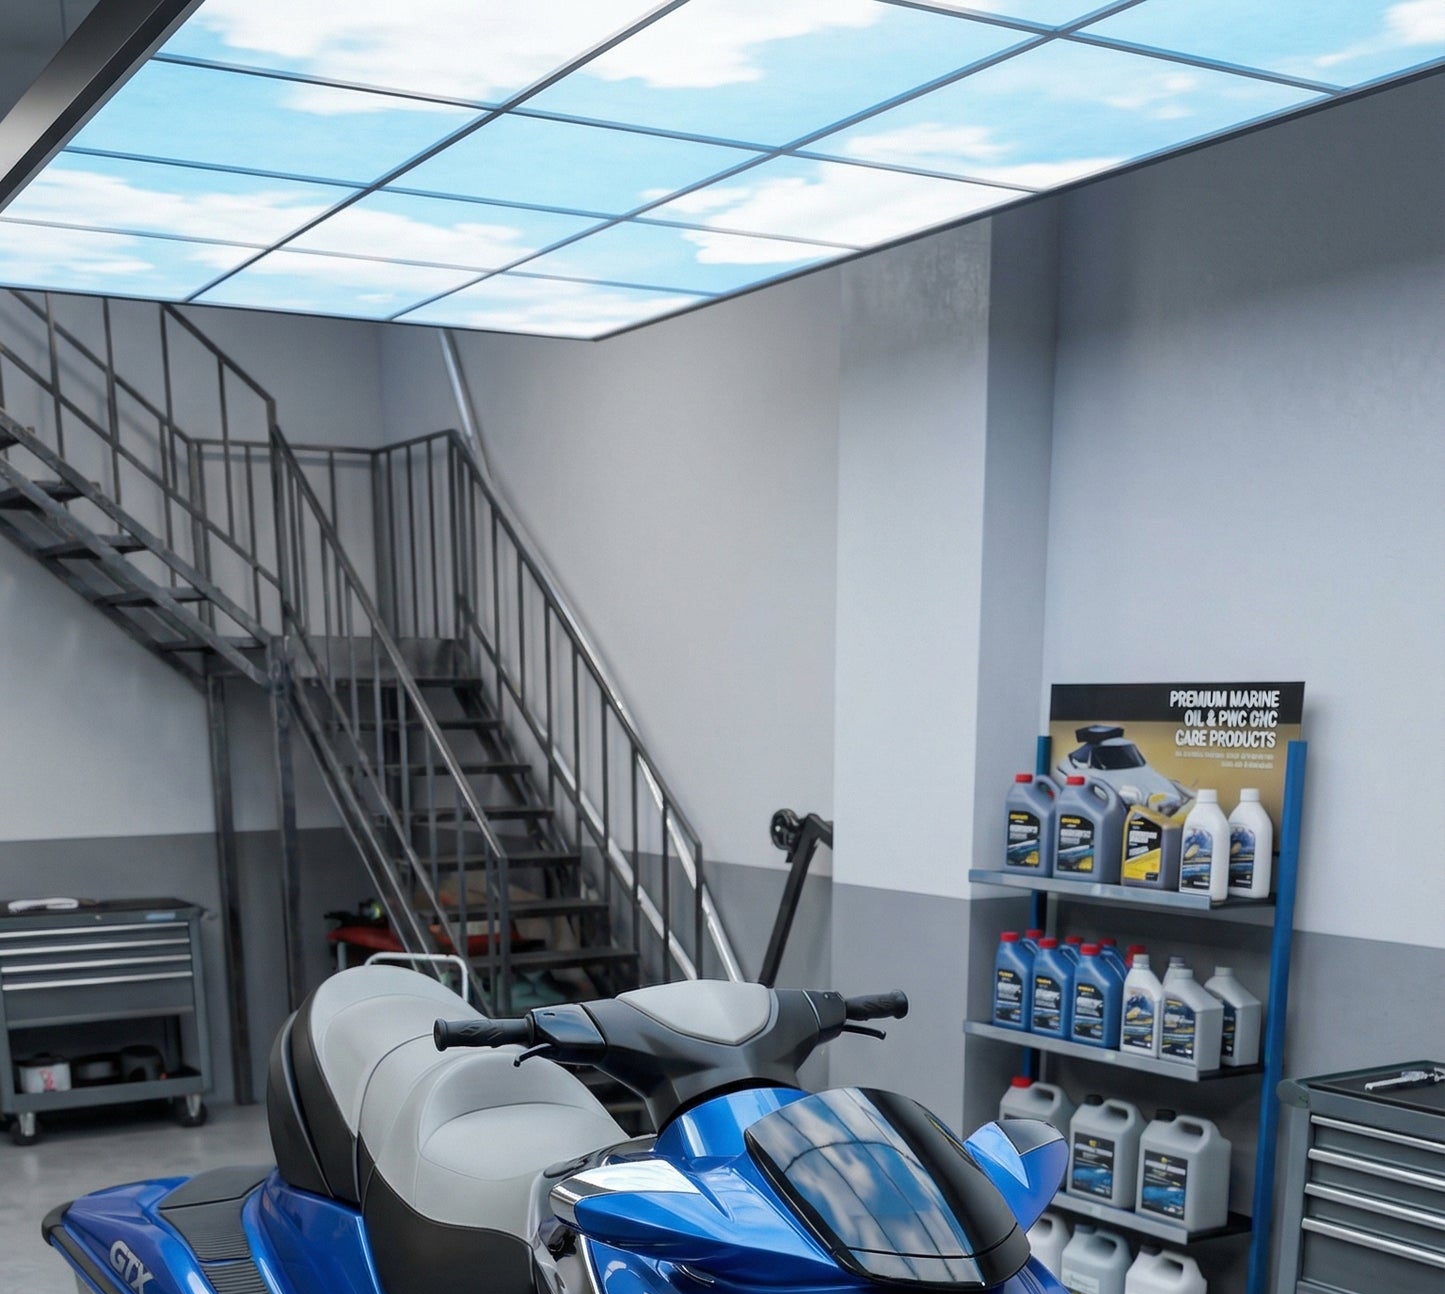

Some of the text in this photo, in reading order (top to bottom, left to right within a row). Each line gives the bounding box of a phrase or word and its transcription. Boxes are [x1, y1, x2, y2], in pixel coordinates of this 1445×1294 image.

[1169, 690, 1281, 709] PREMIUM MARINE
[1184, 709, 1205, 727] OIL
[1206, 709, 1217, 727] &
[1218, 710, 1248, 728] PWC
[1175, 729, 1277, 749] CARE PRODUCTS
